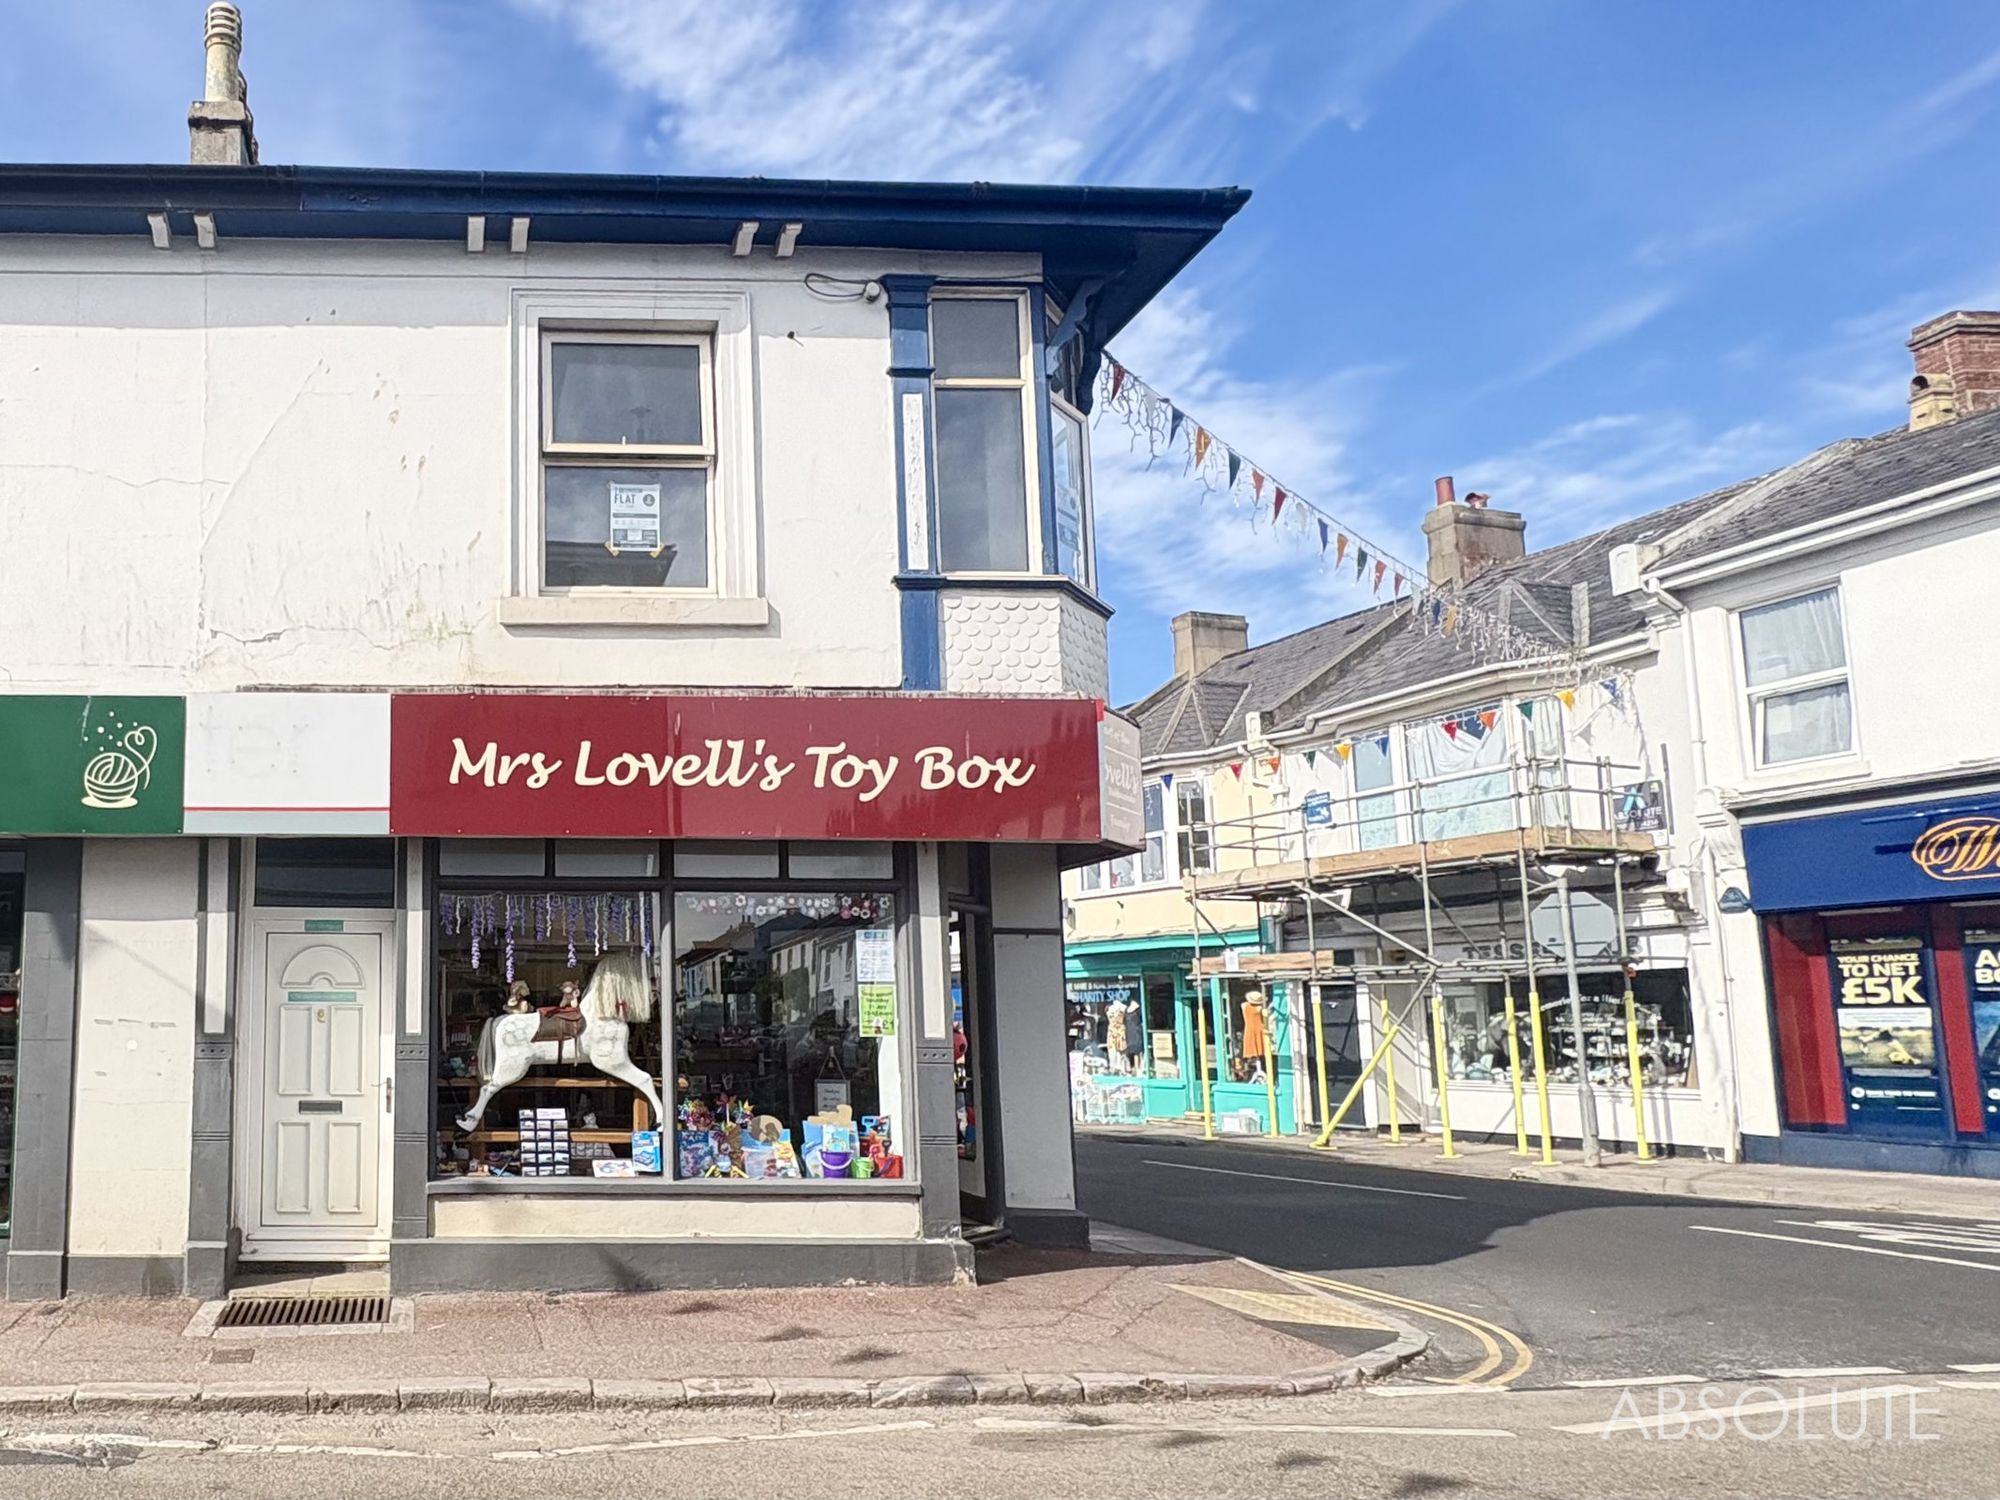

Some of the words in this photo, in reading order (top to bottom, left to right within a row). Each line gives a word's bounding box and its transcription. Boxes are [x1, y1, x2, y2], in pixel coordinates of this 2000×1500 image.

[614, 494, 636, 504] FLAT
[449, 737, 563, 789] Mrs
[574, 739, 796, 792] Lovell's
[805, 741, 899, 802] Toy
[914, 746, 1037, 794] Box
[1104, 762, 1139, 794] ovell's
[1837, 955, 1869, 963] YOUR
[1871, 953, 1919, 962] CHANCE
[1838, 964, 1869, 977] TO
[1873, 962, 1920, 976] NET
[1841, 976, 1926, 1004] £5K
